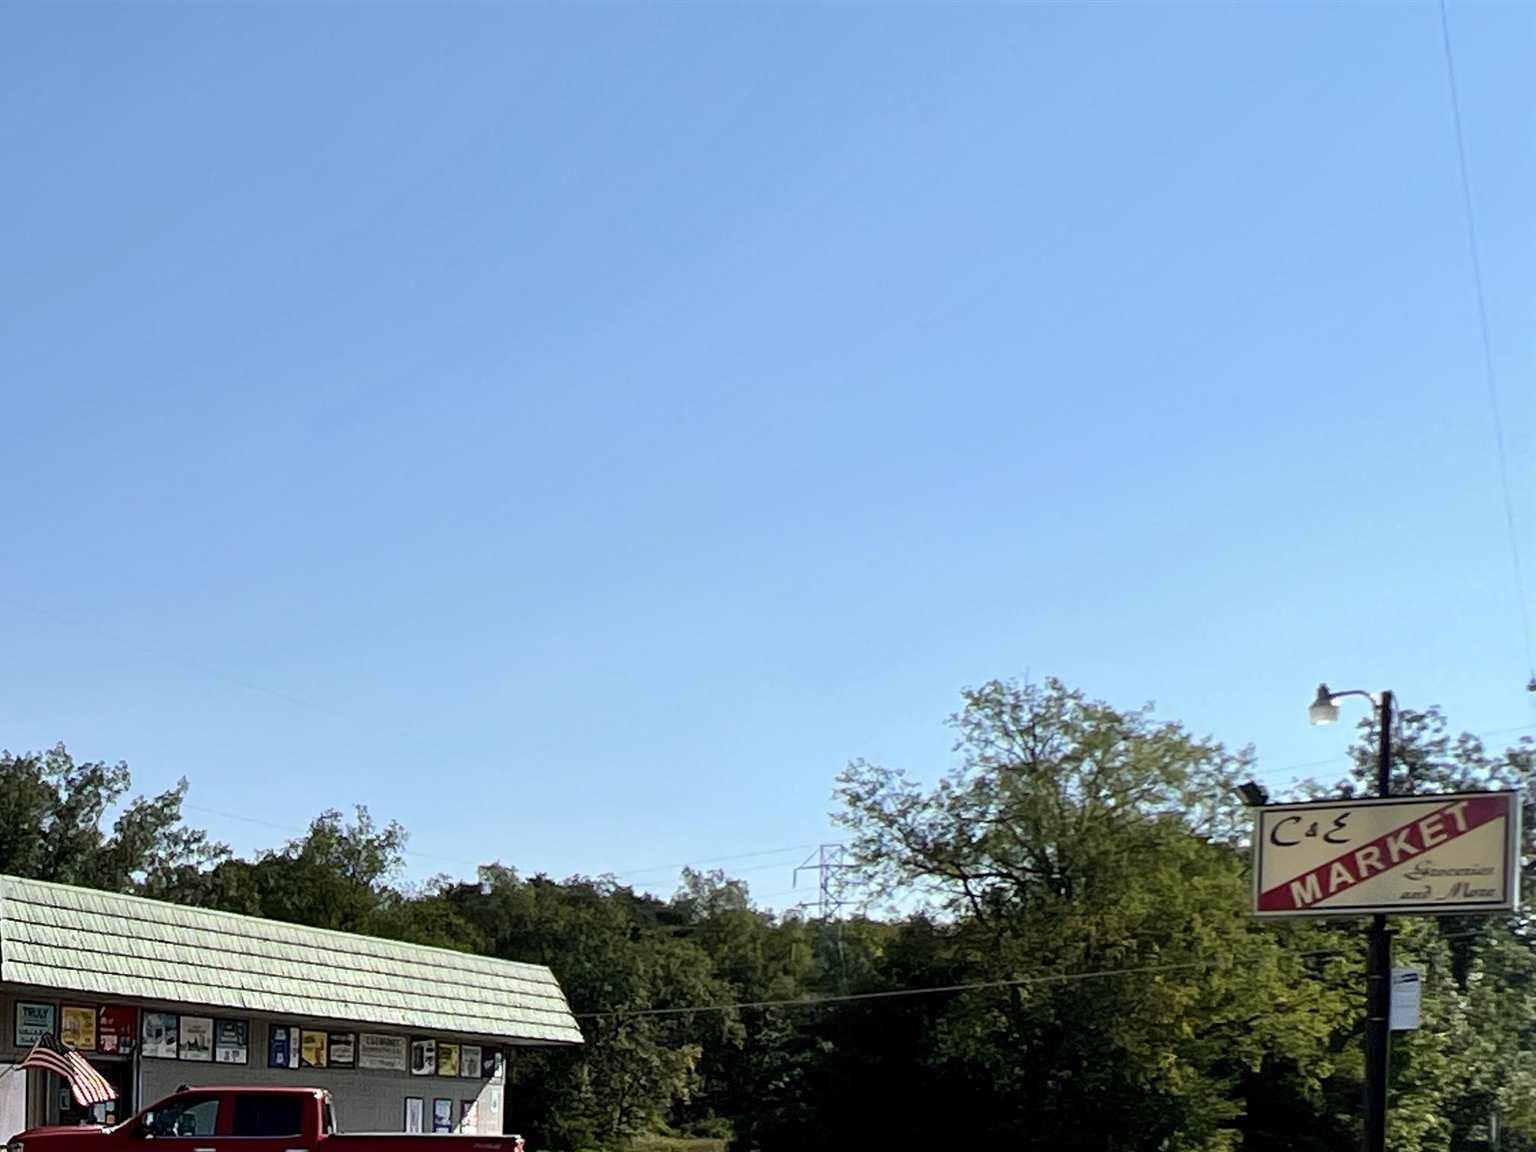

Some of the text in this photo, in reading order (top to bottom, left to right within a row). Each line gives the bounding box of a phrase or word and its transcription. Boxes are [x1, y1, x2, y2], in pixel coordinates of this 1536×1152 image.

[1269, 815, 1302, 847] C
[1323, 811, 1352, 844] E
[1289, 801, 1470, 908] MARKET
